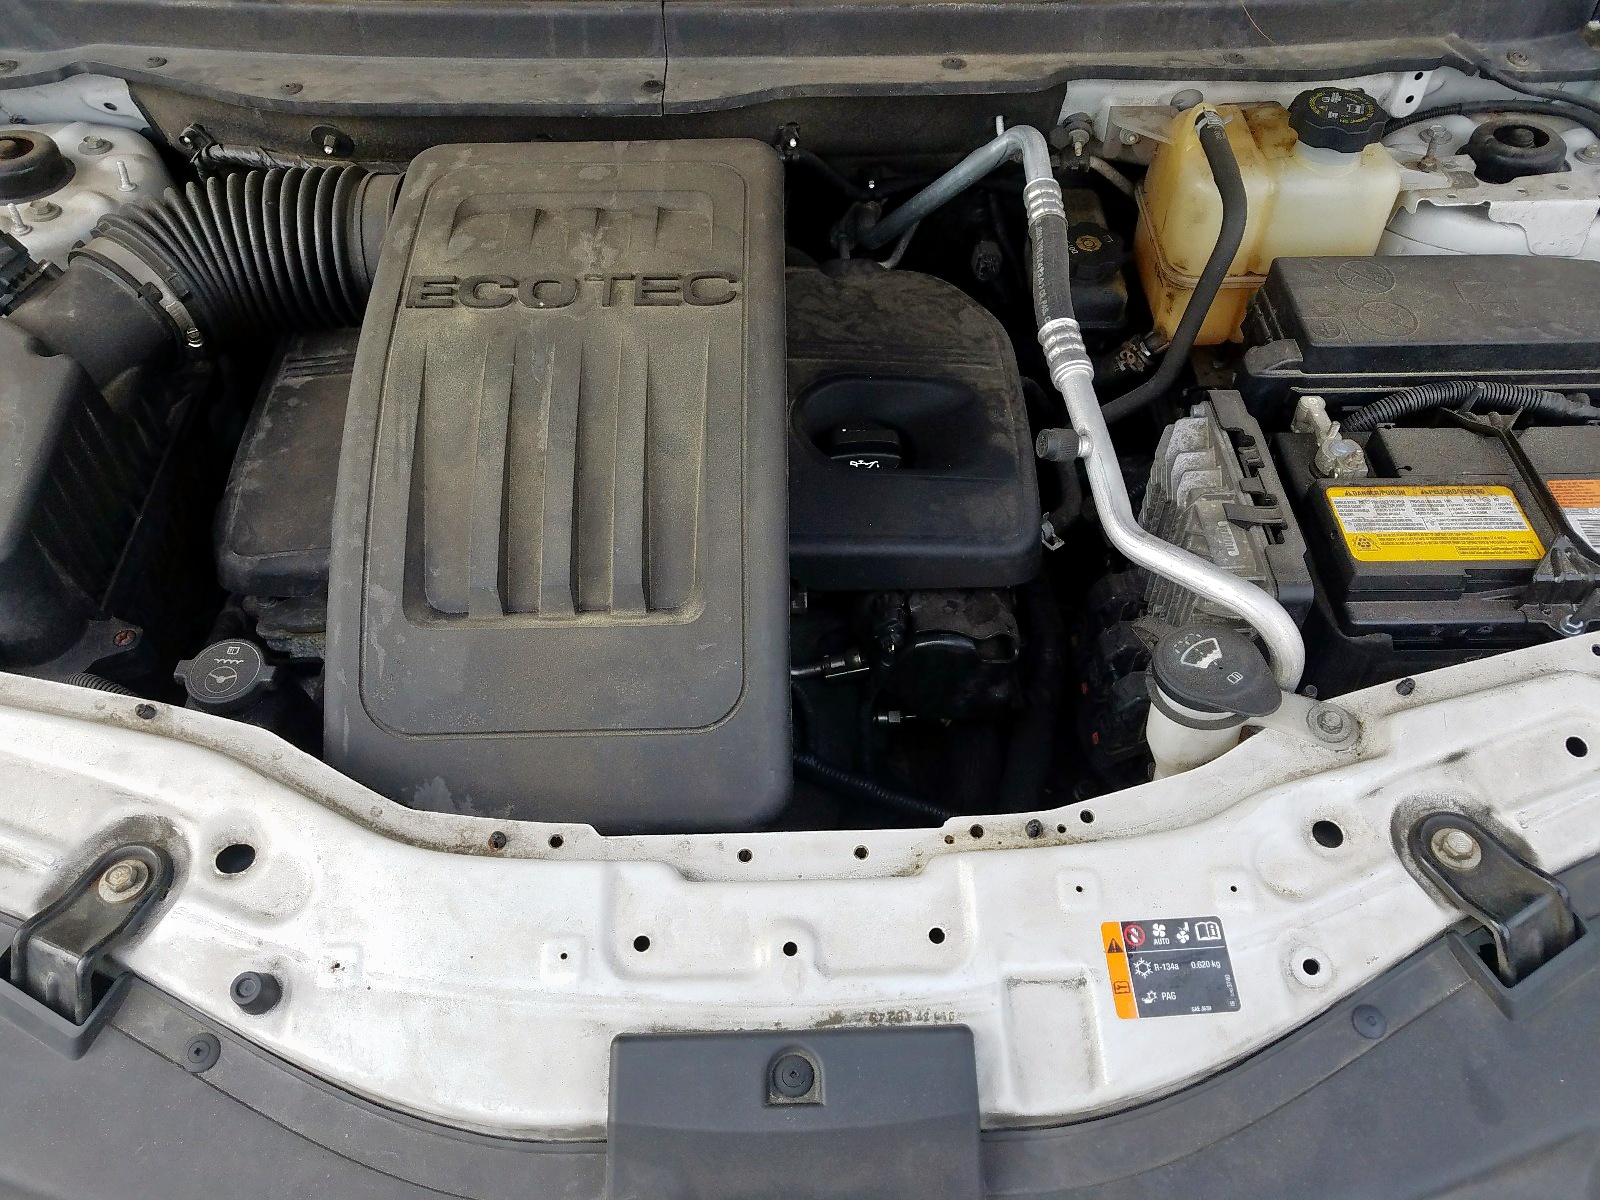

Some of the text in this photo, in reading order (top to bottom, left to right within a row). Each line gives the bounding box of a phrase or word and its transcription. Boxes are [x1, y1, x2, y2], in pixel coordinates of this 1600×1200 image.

[405, 271, 738, 309] ECOTEC
[1153, 960, 1221, 971] R-134a 0.620 kg
[1161, 991, 1177, 1001] PAG
